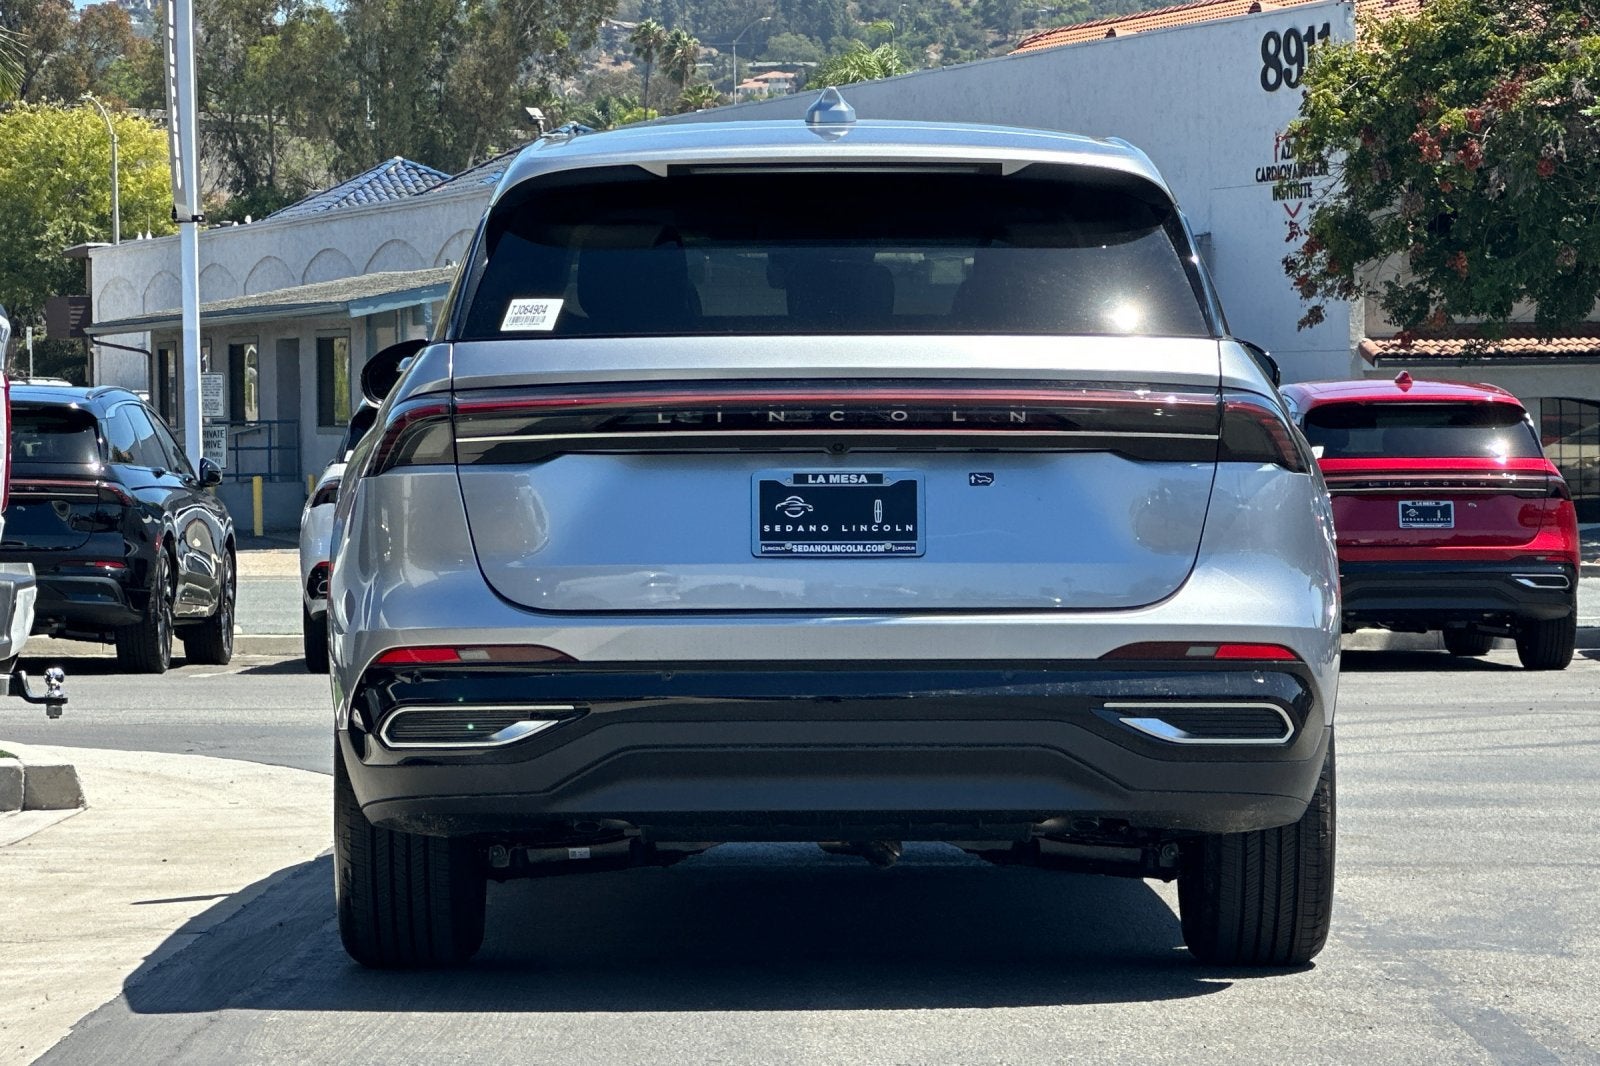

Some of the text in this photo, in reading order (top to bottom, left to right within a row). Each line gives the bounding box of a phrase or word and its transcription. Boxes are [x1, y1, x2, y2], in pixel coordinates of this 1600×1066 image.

[1261, 22, 1330, 92] 891
[657, 410, 1027, 423] LINCOLN
[203, 429, 224, 439] RIVATE
[807, 474, 868, 484] LA MESA
[763, 524, 914, 532] SEDANO LINCOLN
[791, 544, 885, 553] SEDANOLINCOLN.COM
